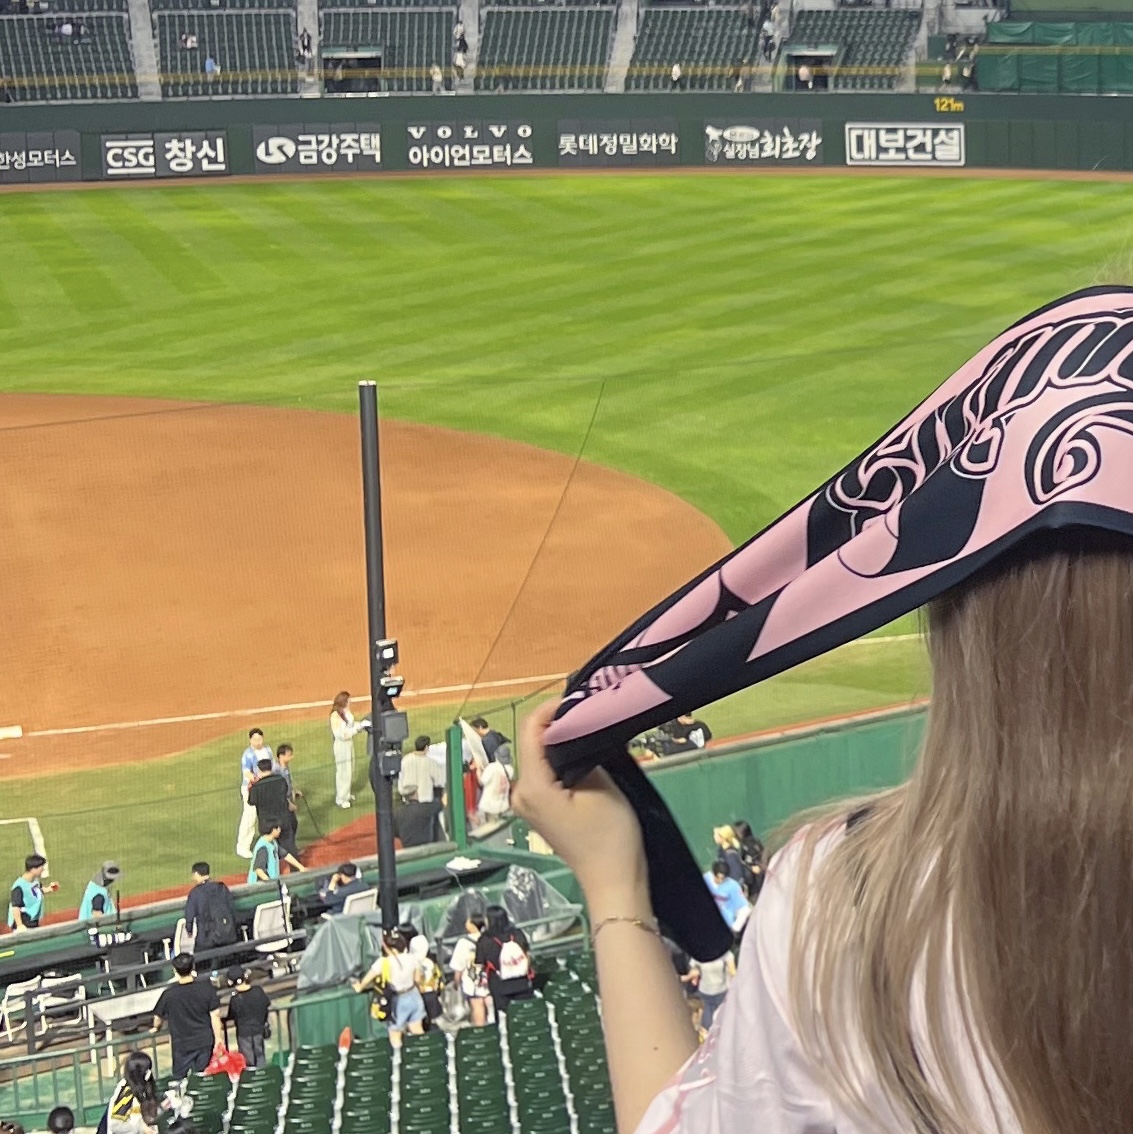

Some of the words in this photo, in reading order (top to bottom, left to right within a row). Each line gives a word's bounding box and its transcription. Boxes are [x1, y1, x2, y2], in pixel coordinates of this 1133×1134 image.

[934, 97, 964, 112] 121m
[408, 124, 532, 140] VOLVO
[165, 137, 226, 172] 창신
[298, 132, 381, 165] 금강주택
[409, 144, 533, 167] 아이언모터스
[558, 133, 679, 156] 롯데정밀화학
[849, 127, 961, 161] 대보건설
[107, 147, 154, 168] CSG
